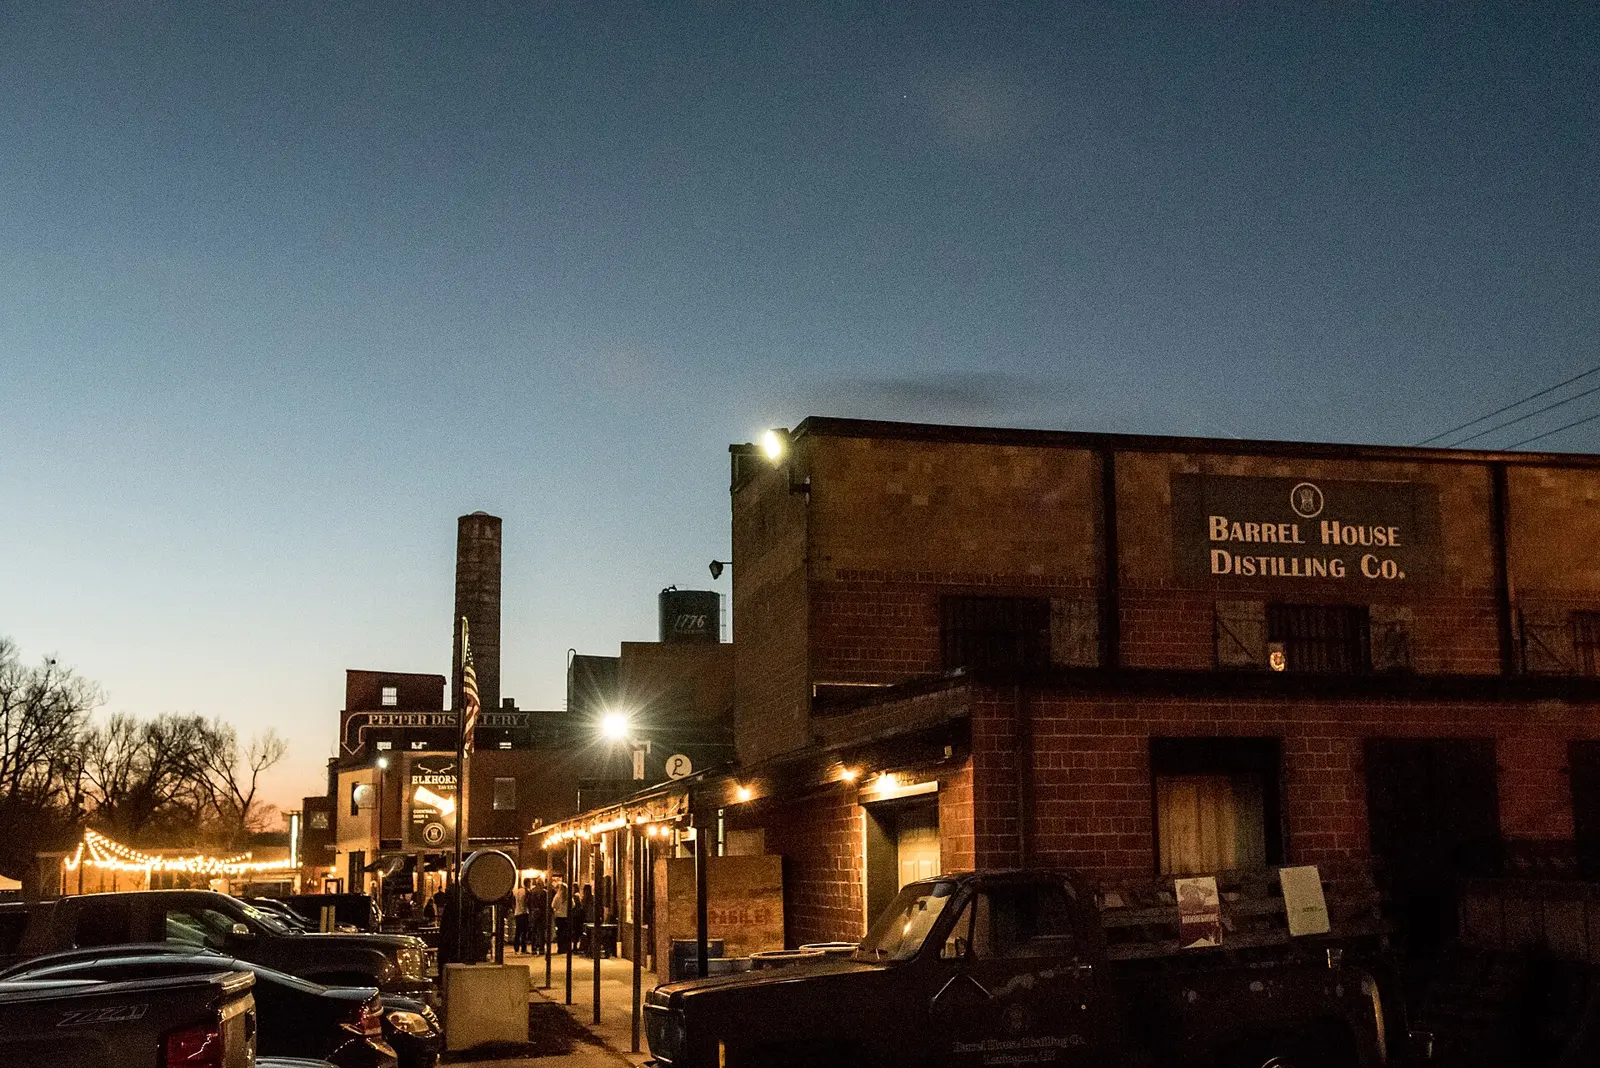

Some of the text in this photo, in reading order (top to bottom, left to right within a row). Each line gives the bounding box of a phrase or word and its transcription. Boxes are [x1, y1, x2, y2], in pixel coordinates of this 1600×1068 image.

[1209, 516, 1402, 547] BARREL HOUSE
[1210, 549, 1346, 578] DISTILLING
[674, 614, 707, 631] 1776
[368, 713, 520, 726] PEPPER DISLERY
[411, 775, 458, 785] ELKHORN
